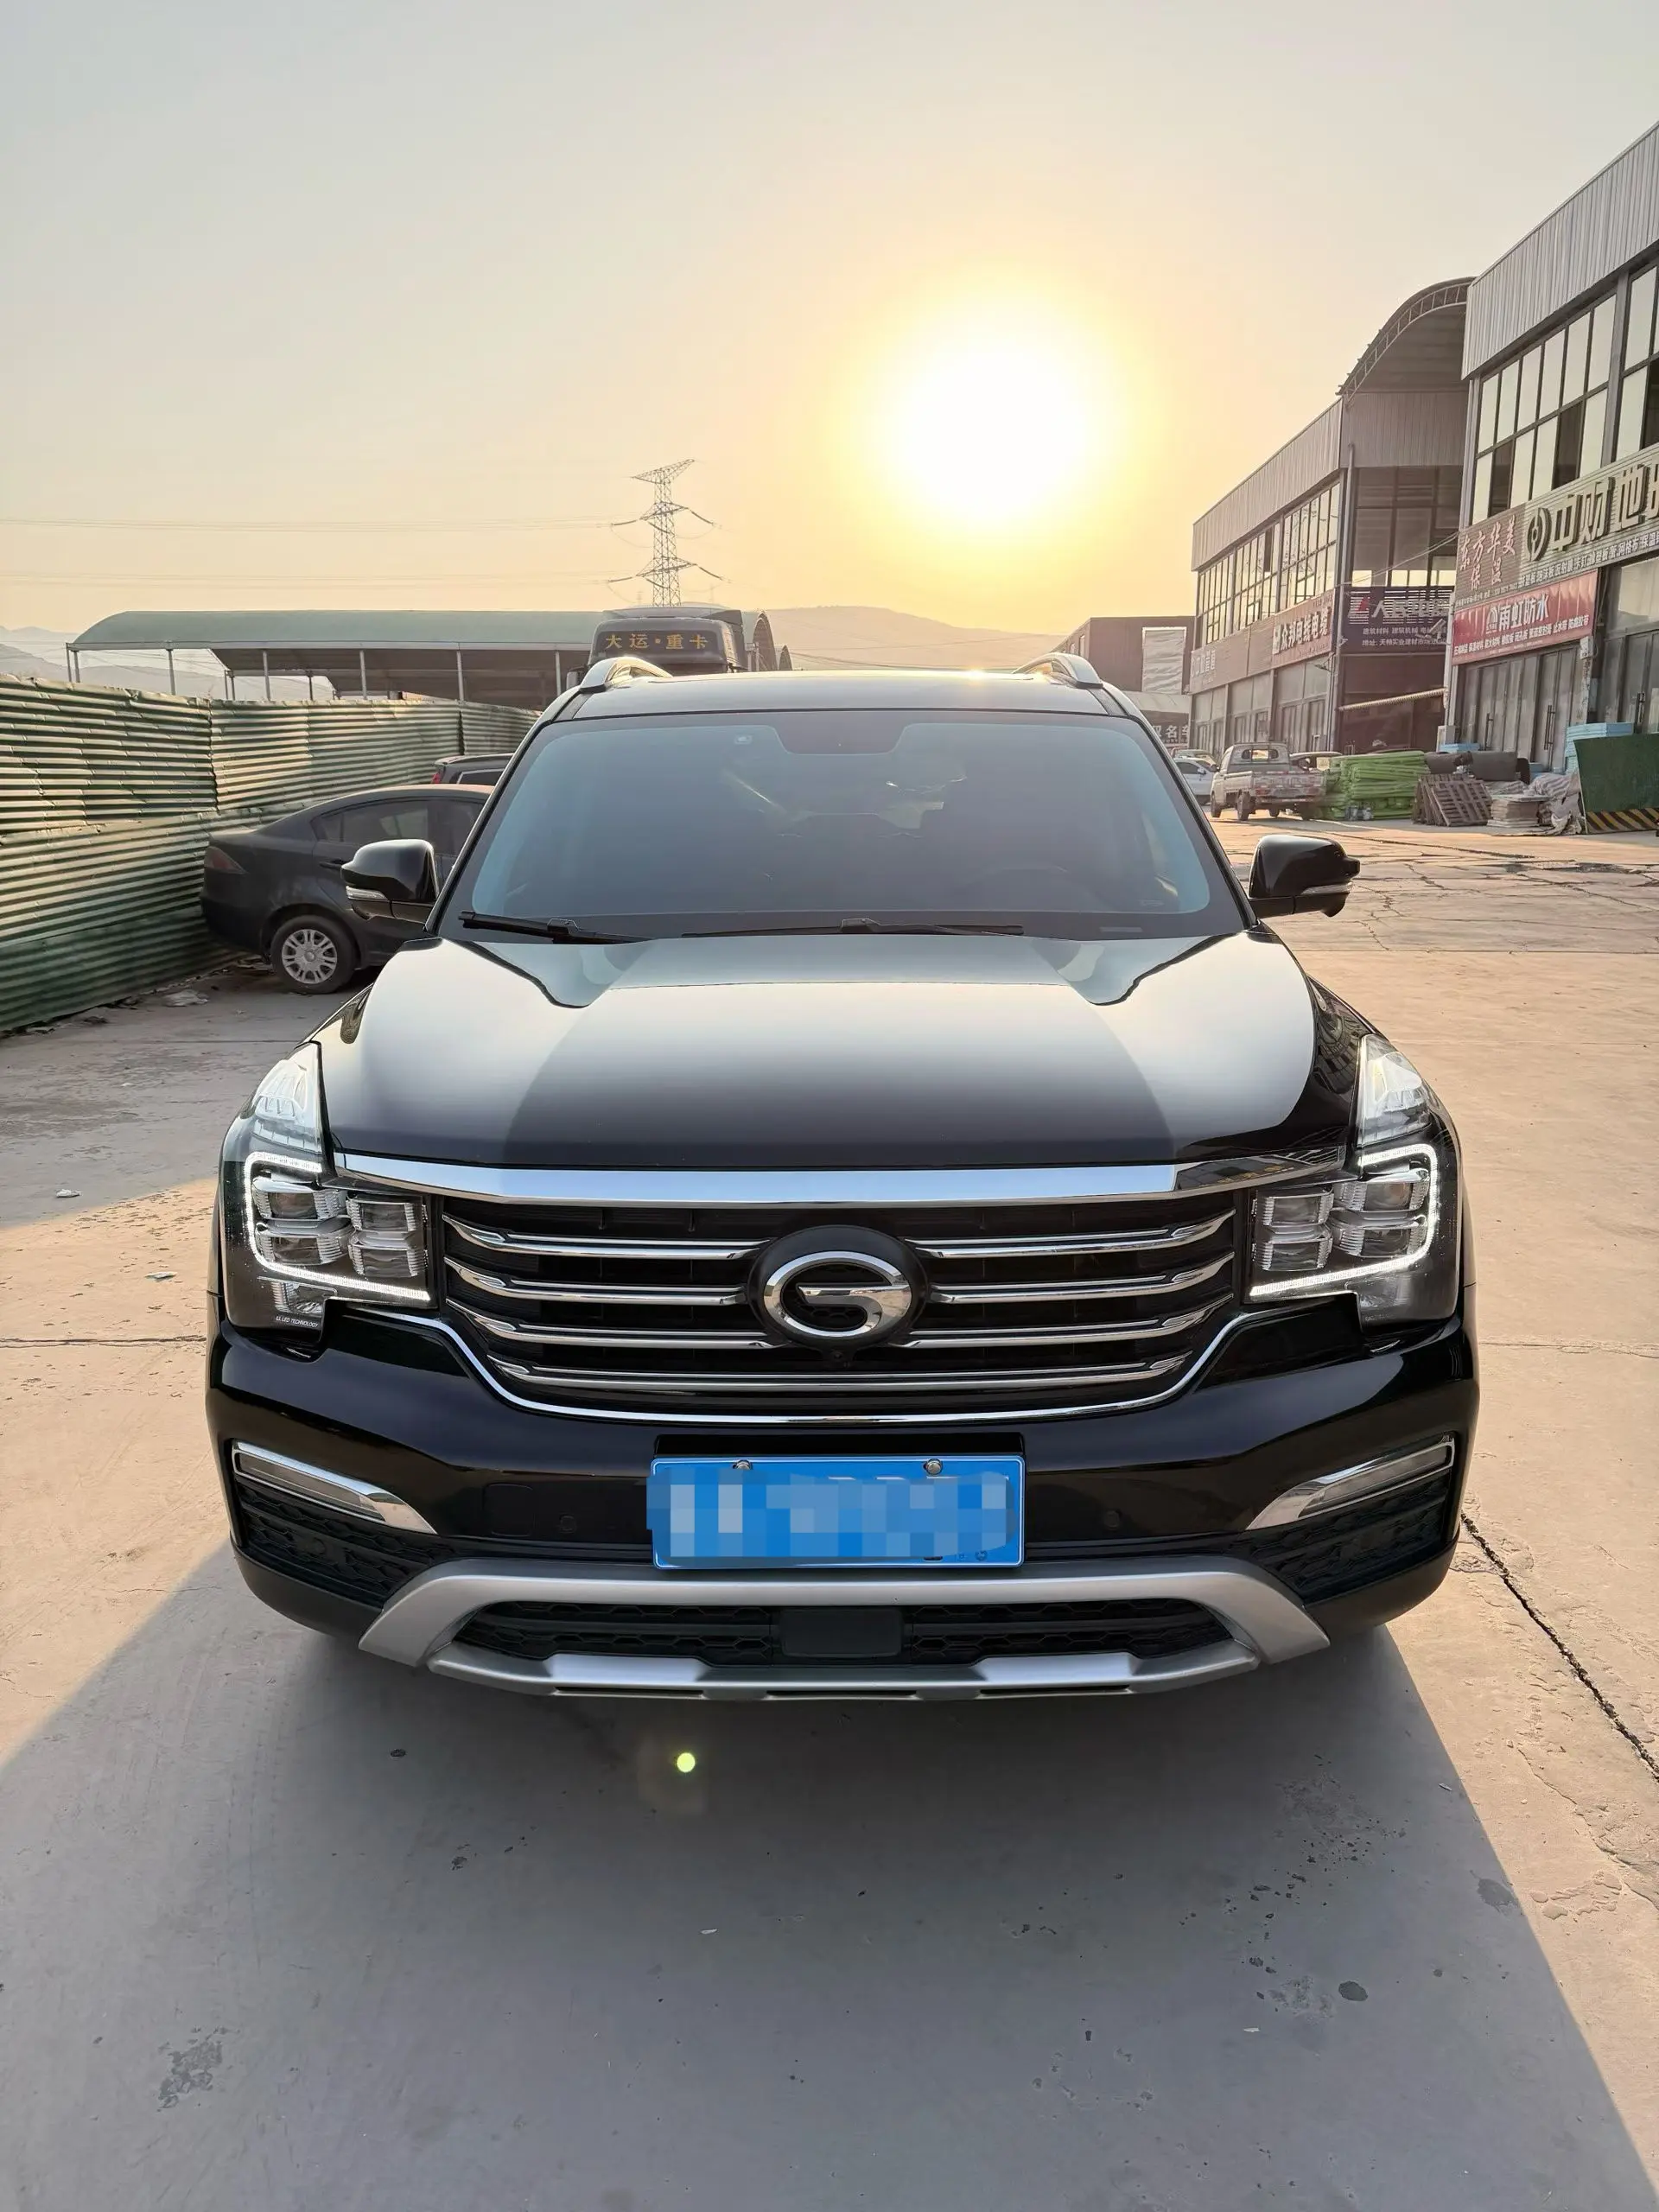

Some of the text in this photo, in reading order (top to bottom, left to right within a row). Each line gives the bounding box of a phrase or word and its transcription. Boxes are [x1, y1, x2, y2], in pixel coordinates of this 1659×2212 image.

[1553, 457, 1659, 551] 中财地
[1459, 514, 1516, 571] 东方华美
[1471, 556, 1502, 589] 保温
[1499, 592, 1549, 632] 雨虹防水
